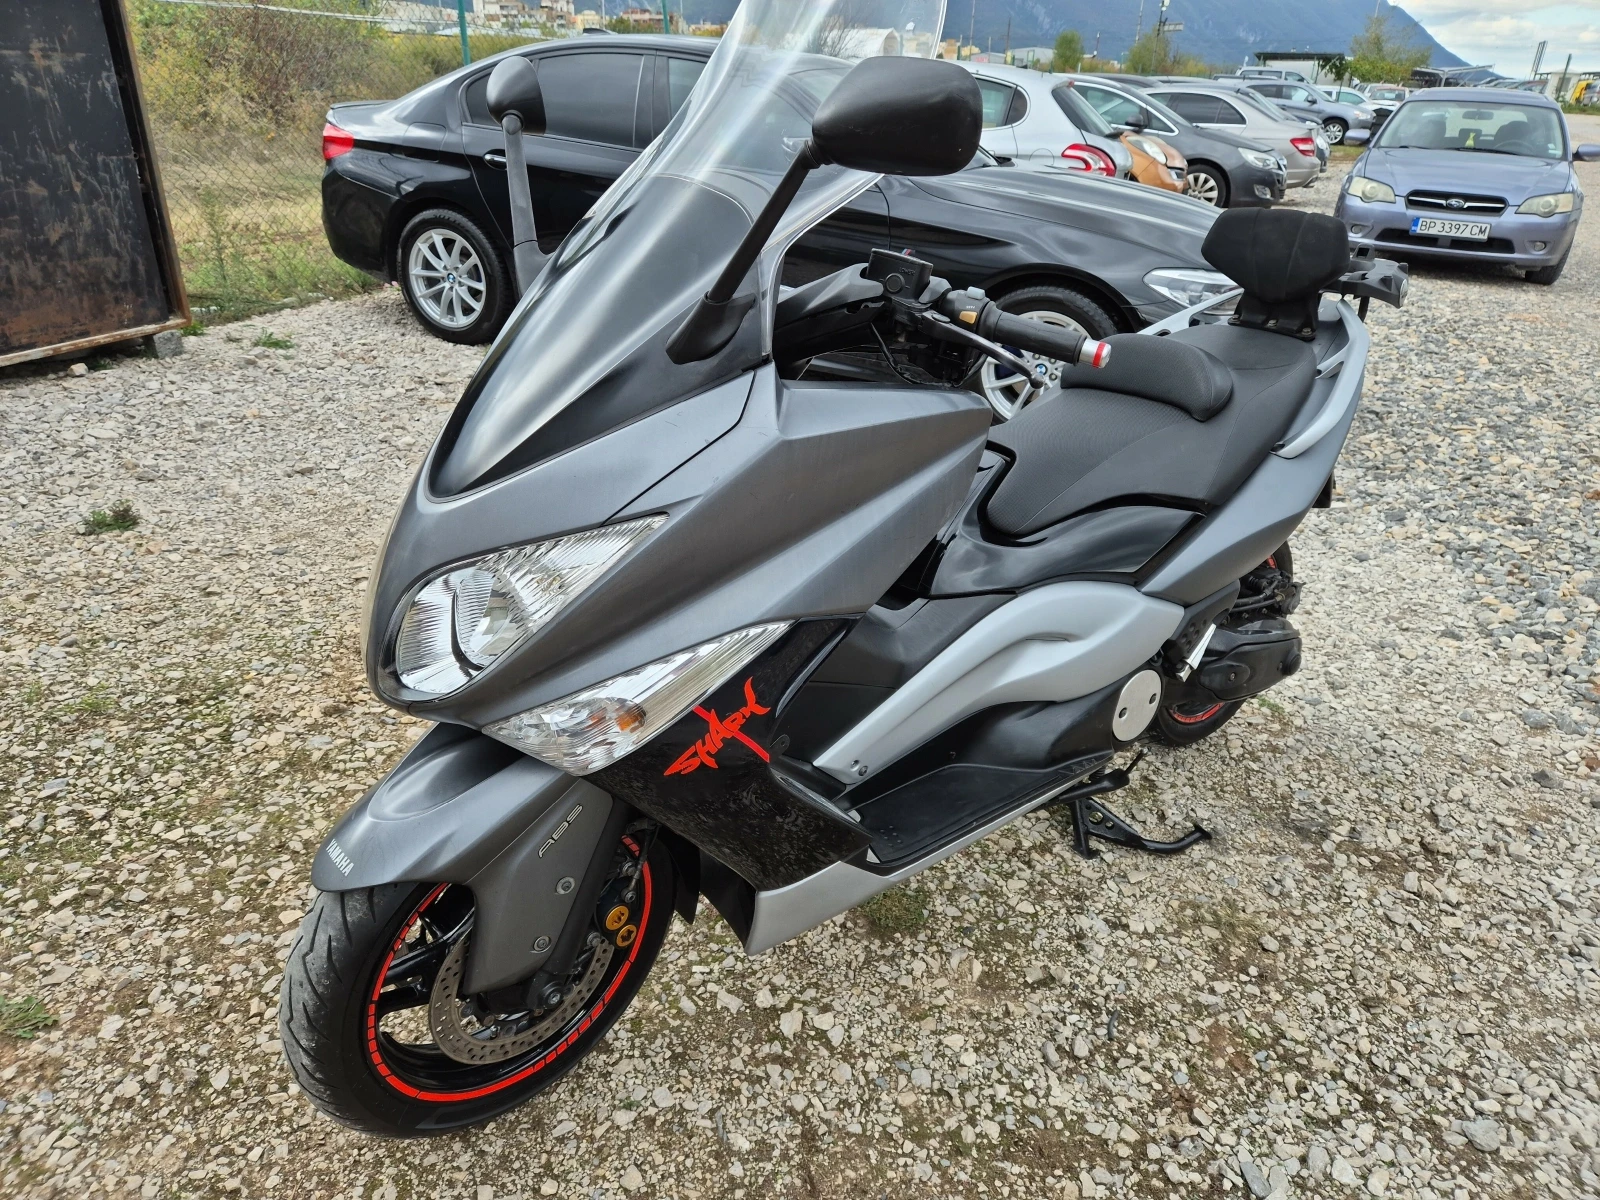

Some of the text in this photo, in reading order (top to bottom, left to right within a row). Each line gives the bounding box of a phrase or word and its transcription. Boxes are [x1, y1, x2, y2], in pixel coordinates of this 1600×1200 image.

[1419, 220, 1488, 237] BP 3397 CM
[663, 675, 771, 776] SHARK
[538, 804, 583, 858] ABS
[325, 838, 354, 877] YAMAHA
